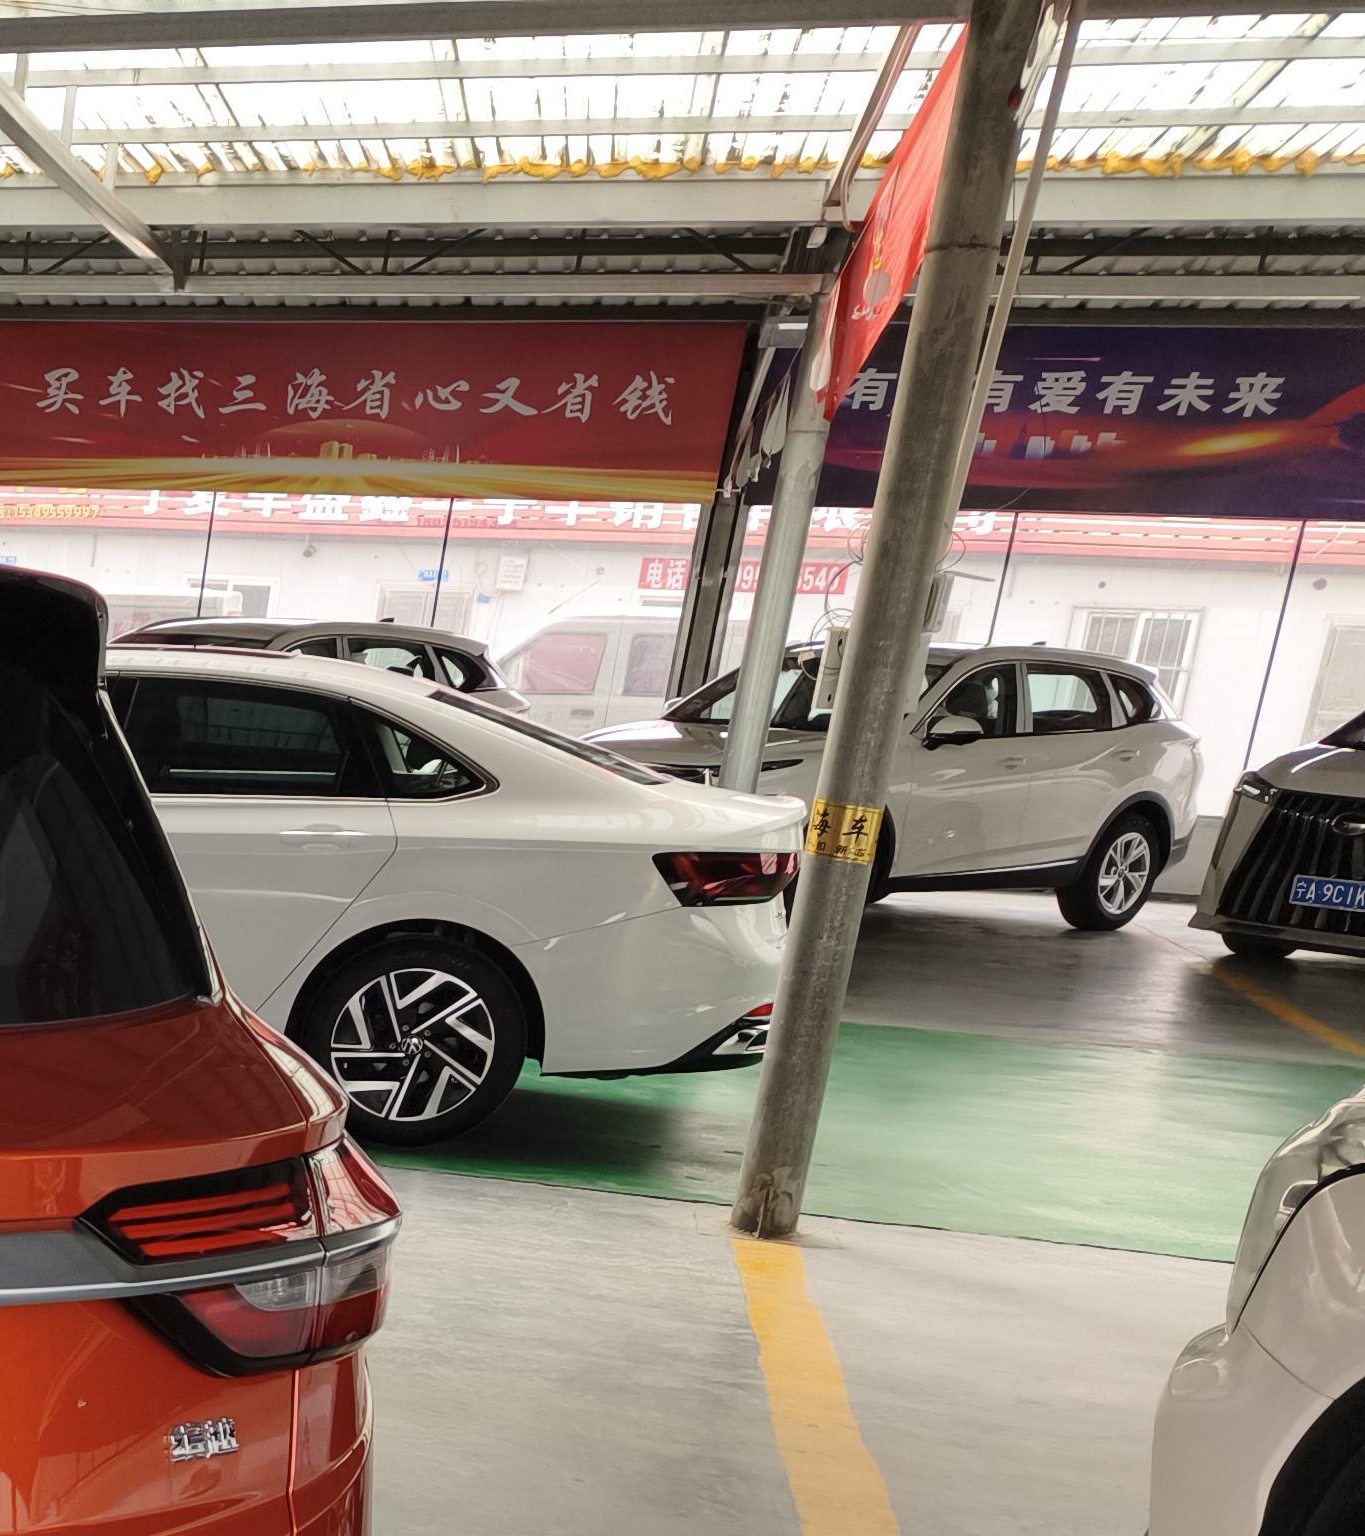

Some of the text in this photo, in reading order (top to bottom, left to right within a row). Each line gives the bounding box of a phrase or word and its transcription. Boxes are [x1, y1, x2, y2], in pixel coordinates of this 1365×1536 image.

[35, 366, 676, 426] 买车找三海省心又省钱
[845, 366, 1287, 418] 有有爱有未来
[646, 557, 690, 592] 电话
